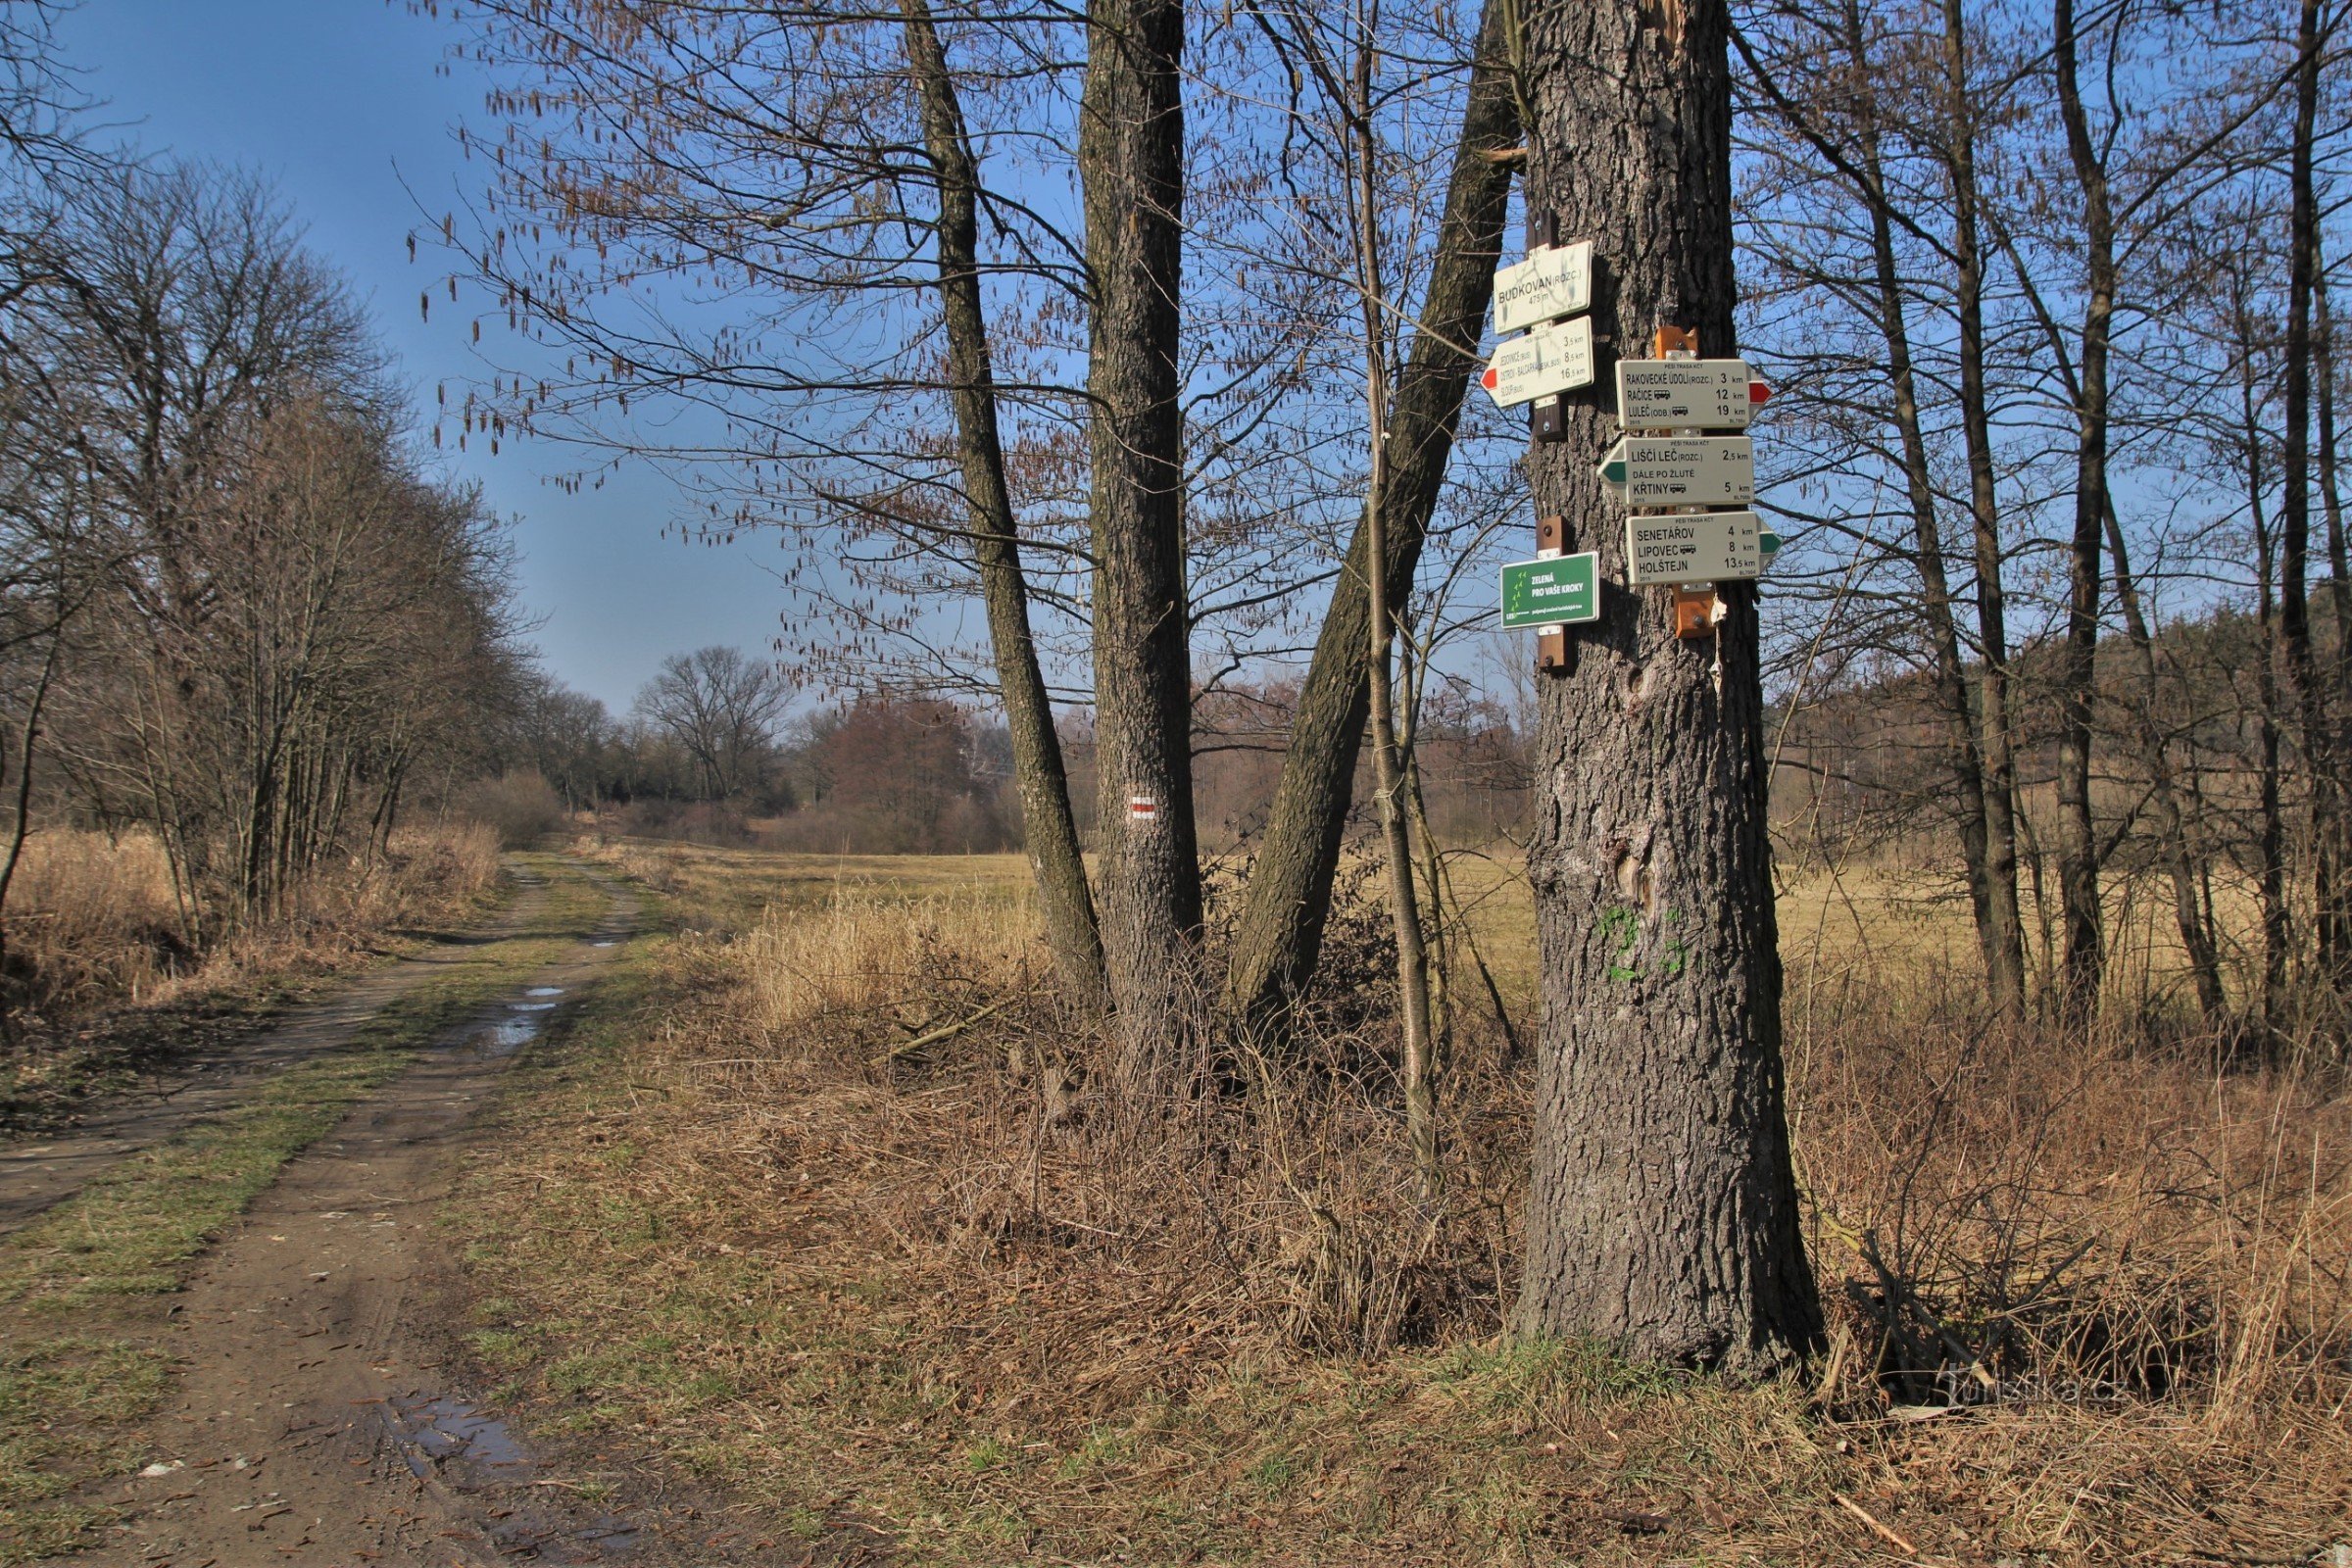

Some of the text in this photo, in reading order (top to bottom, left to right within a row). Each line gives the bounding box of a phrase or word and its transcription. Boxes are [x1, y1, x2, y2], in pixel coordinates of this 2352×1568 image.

[1529, 294, 1541, 305] 475
[1563, 335, 1573, 348] 3,5
[1564, 351, 1575, 364] 8,5
[1560, 368, 1576, 380] 16,5
[1626, 371, 1667, 385] RAKOVECKÉ
[1720, 372, 1743, 384] 3 km
[1627, 388, 1652, 401] RAČICE
[1715, 388, 1729, 400] 12
[1628, 404, 1650, 417] LULEČ
[1716, 405, 1730, 416] 19
[1632, 450, 1656, 463] LIŠČÍ
[1658, 449, 1678, 462] LEČ
[1722, 450, 1748, 462] 2,5 km
[1633, 470, 1654, 479] DÁLE
[1669, 468, 1694, 478] ŽLUTÉ
[1633, 482, 1669, 496] KŘTINY
[1724, 481, 1750, 493] 5 km
[1637, 526, 1695, 542] SENETÁŘOV
[1728, 525, 1735, 536] 4
[1638, 545, 1679, 559] LIPOVEC
[1729, 541, 1736, 553] 8
[1639, 560, 1689, 574] HOLŠTEJN
[1725, 558, 1743, 569] 13,5
[1532, 572, 1554, 585] ZELENÁ
[1531, 582, 1584, 598] PRO VAŠE KROKY
